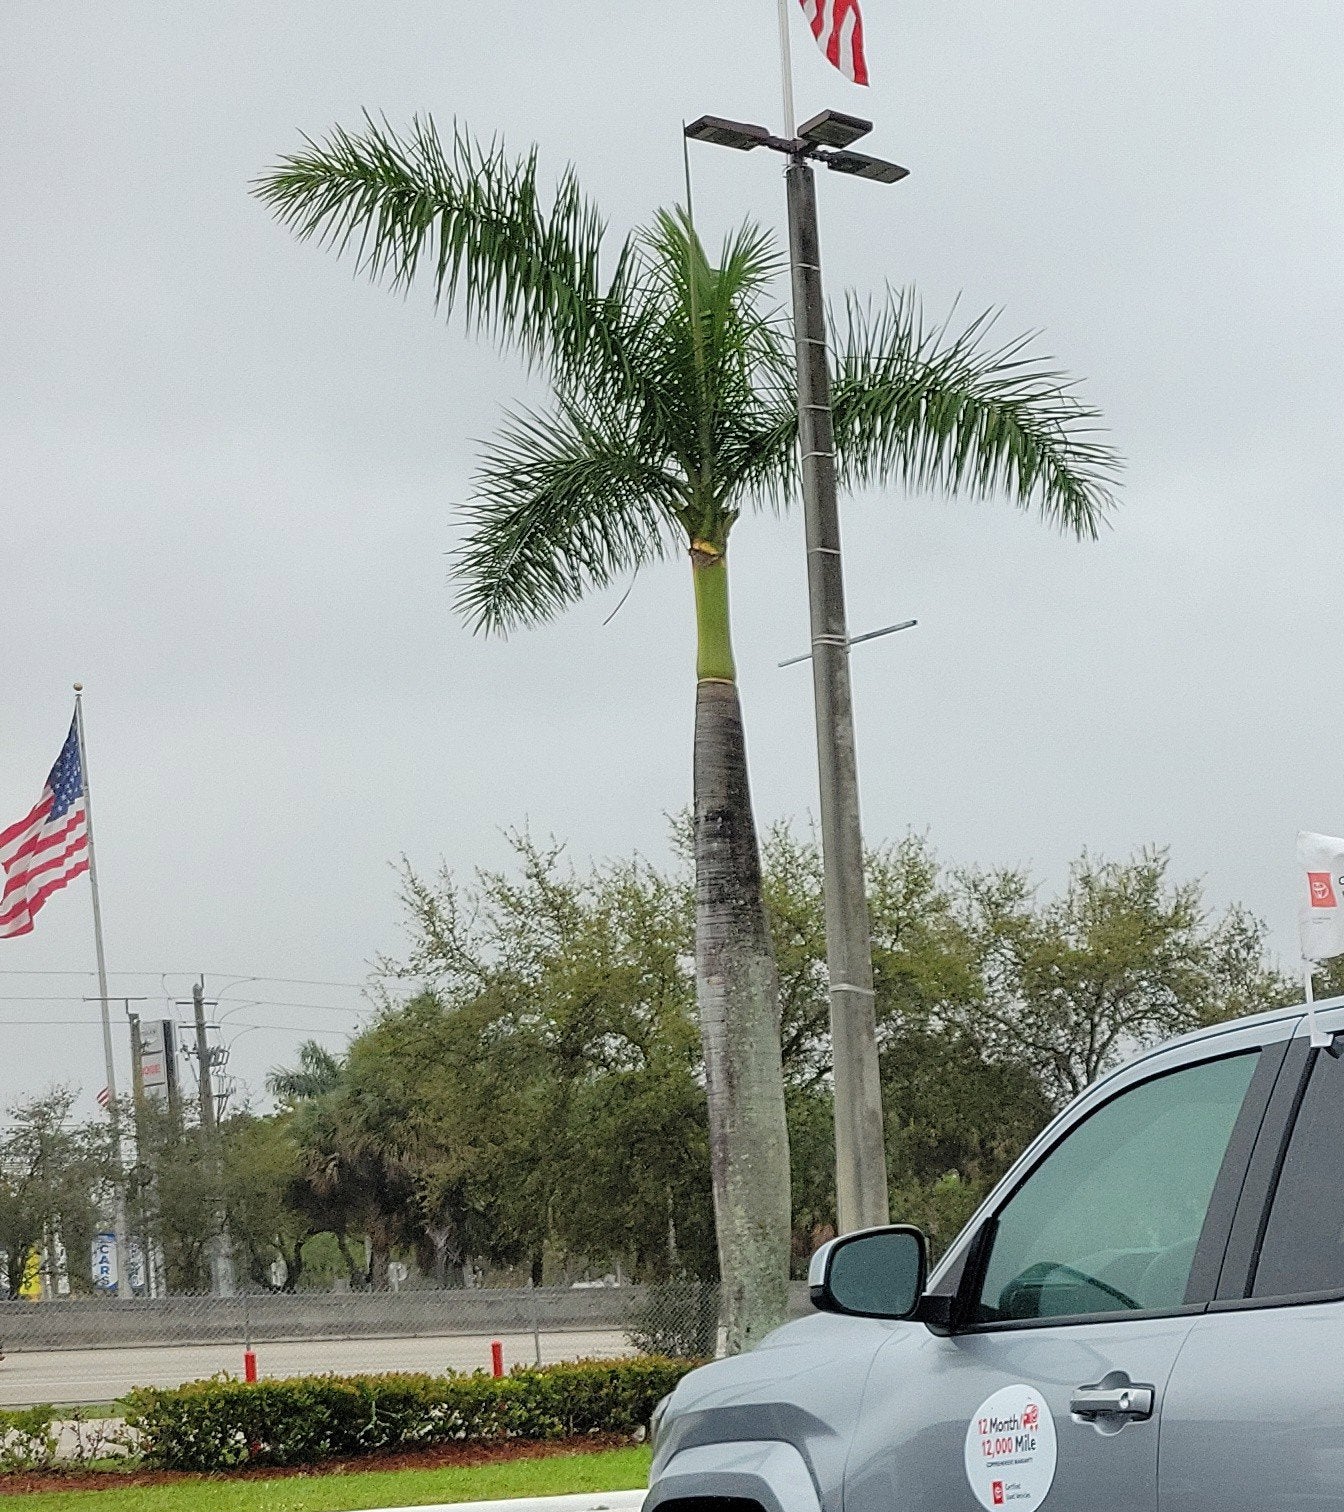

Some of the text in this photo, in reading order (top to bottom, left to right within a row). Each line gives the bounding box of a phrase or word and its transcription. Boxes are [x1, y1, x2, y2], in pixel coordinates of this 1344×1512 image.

[99, 1244, 110, 1286] CARS
[978, 1418, 988, 1435] 12
[982, 1434, 1037, 1458] 12,000 Mile
